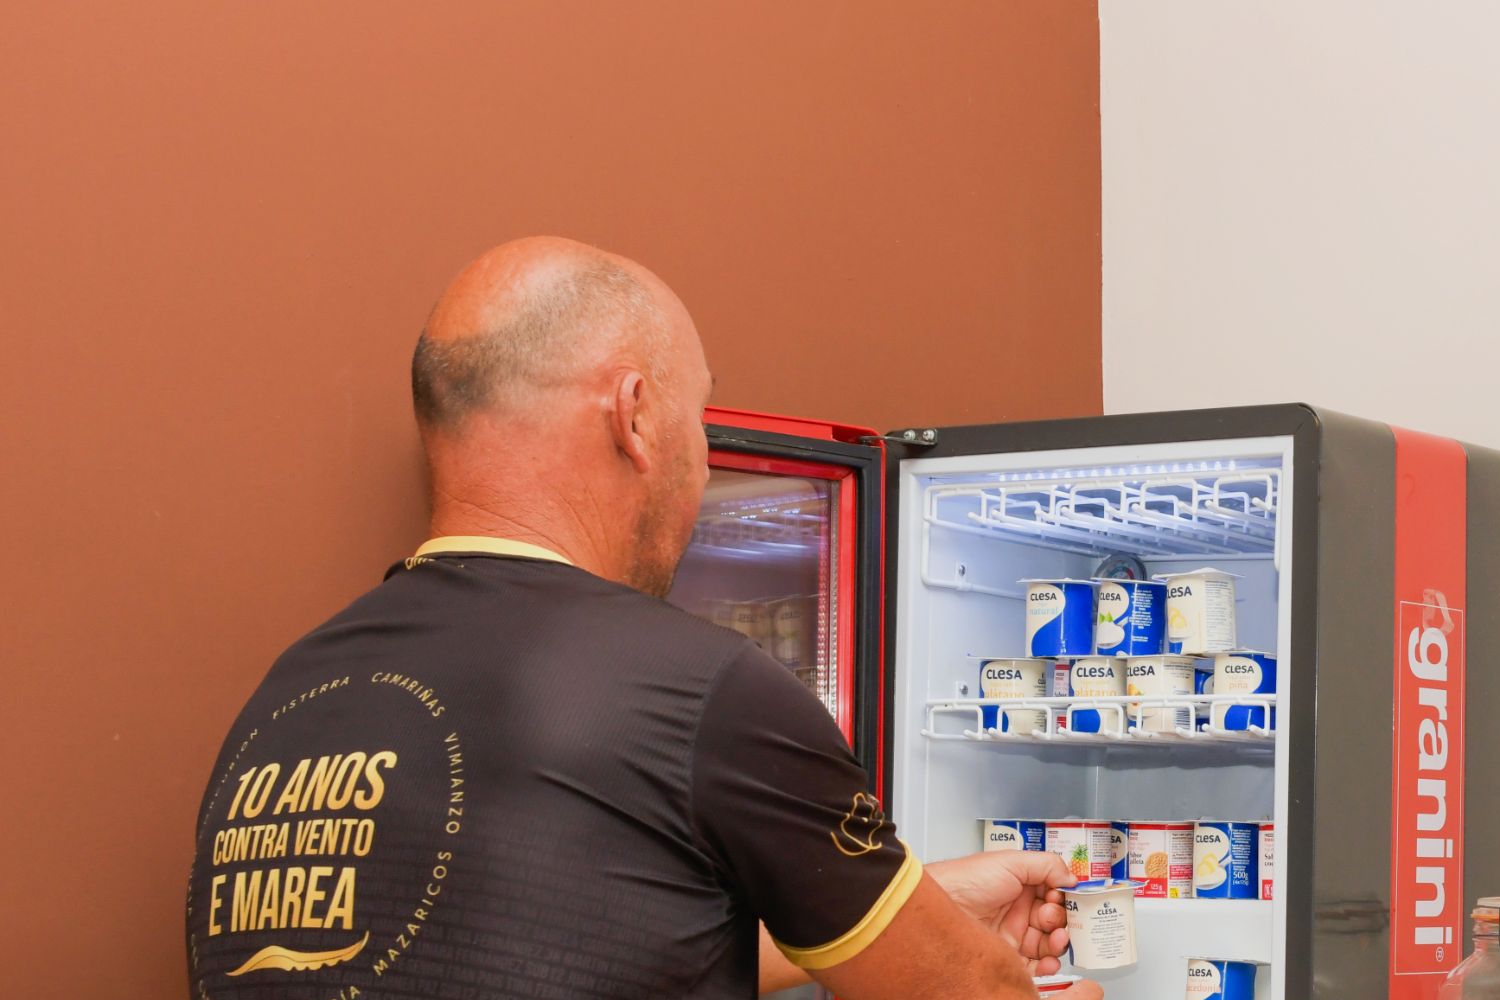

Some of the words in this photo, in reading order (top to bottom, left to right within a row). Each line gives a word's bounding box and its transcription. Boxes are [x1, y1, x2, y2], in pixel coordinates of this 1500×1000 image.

[273, 676, 350, 719] FISTERRA
[371, 671, 445, 717] CAMARIÑAS
[227, 763, 281, 821] 10
[272, 751, 398, 815] ANOS
[444, 732, 464, 834] VIMIANZO
[1408, 627, 1453, 944] granini
[213, 822, 290, 866] CONTRA
[294, 819, 375, 856] VENTO
[208, 874, 227, 937] E
[231, 866, 356, 932] MAREA
[373, 851, 452, 976] MAZARICOS
